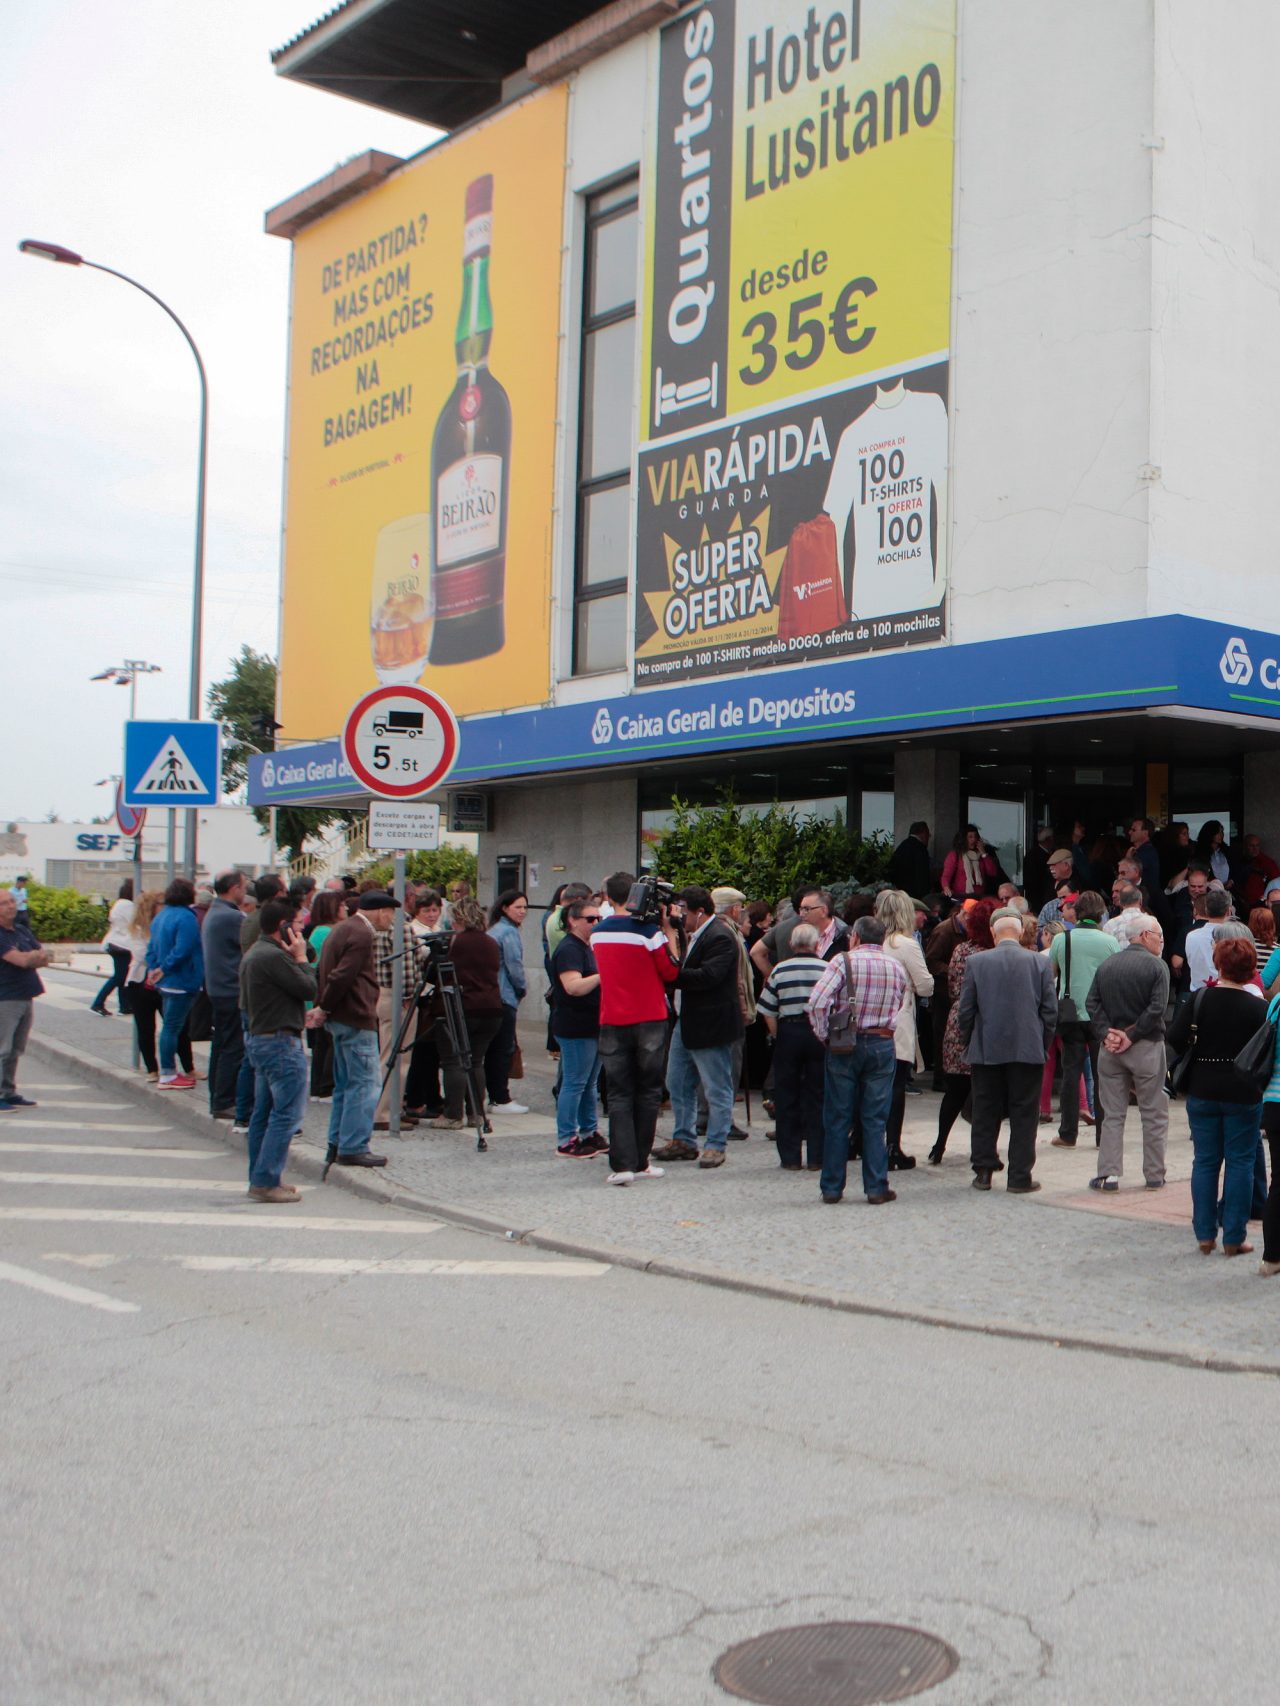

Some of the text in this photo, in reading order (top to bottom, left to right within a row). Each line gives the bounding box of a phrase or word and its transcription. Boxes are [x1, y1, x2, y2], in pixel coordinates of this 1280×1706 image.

[747, 0, 861, 112] Hotel
[745, 62, 941, 202] Lusitano
[667, 8, 716, 345] Quartos
[322, 212, 428, 294] DE PARTIDA?
[740, 248, 828, 302] desde
[333, 261, 411, 327] MAS COM
[310, 292, 434, 376] RECORDAÇÕES
[738, 275, 878, 386] 35€
[356, 357, 380, 395] NA
[323, 383, 413, 448] BAGAGEM!
[858, 447, 868, 455] NA
[869, 439, 896, 452] COMPRA
[859, 448, 905, 505] 100
[870, 476, 923, 502] T-SHIRTS
[441, 489, 496, 529] BEIRÃO
[678, 484, 769, 519] GUARDA
[888, 497, 923, 514] OFERTA
[877, 506, 923, 549] 100
[674, 530, 760, 591] SUPER
[877, 547, 922, 565] MOCHILAS
[664, 573, 772, 636] OFERTA
[637, 614, 941, 675] Na compra de 100 T-SHIRTS modelo DOGO, oferta de 100 mochilas
[663, 639, 690, 651] PROMOÇÃO
[616, 712, 664, 742] Caixa
[666, 703, 716, 735] Geral
[719, 701, 744, 728] de
[276, 763, 306, 785] Caixa
[306, 758, 337, 781] Geral
[376, 811, 400, 819] Exceto
[76, 833, 121, 851] SEF
